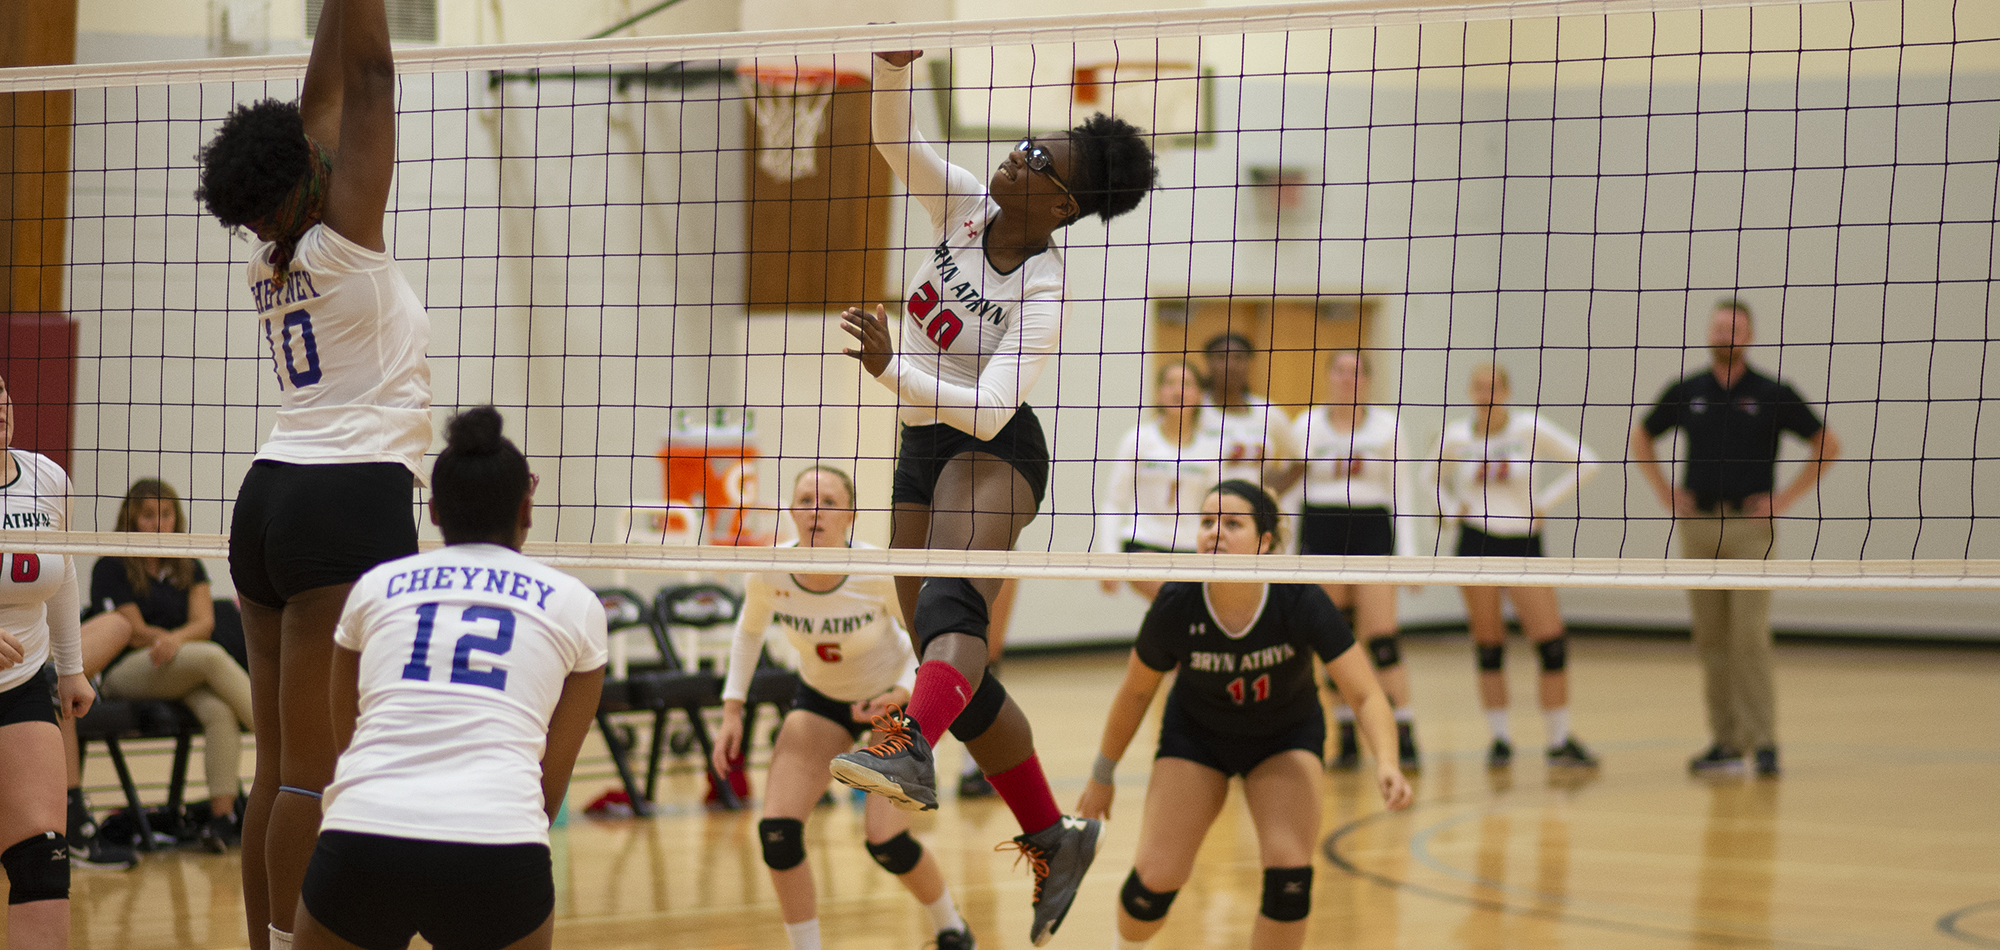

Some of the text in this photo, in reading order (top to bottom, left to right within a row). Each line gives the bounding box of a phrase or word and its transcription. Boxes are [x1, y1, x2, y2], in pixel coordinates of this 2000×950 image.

[251, 270, 321, 314] HEYNEY
[908, 281, 964, 351] 20
[386, 566, 556, 611] CHEYNEY
[402, 601, 516, 691] 12
[1226, 674, 1270, 705] 11
